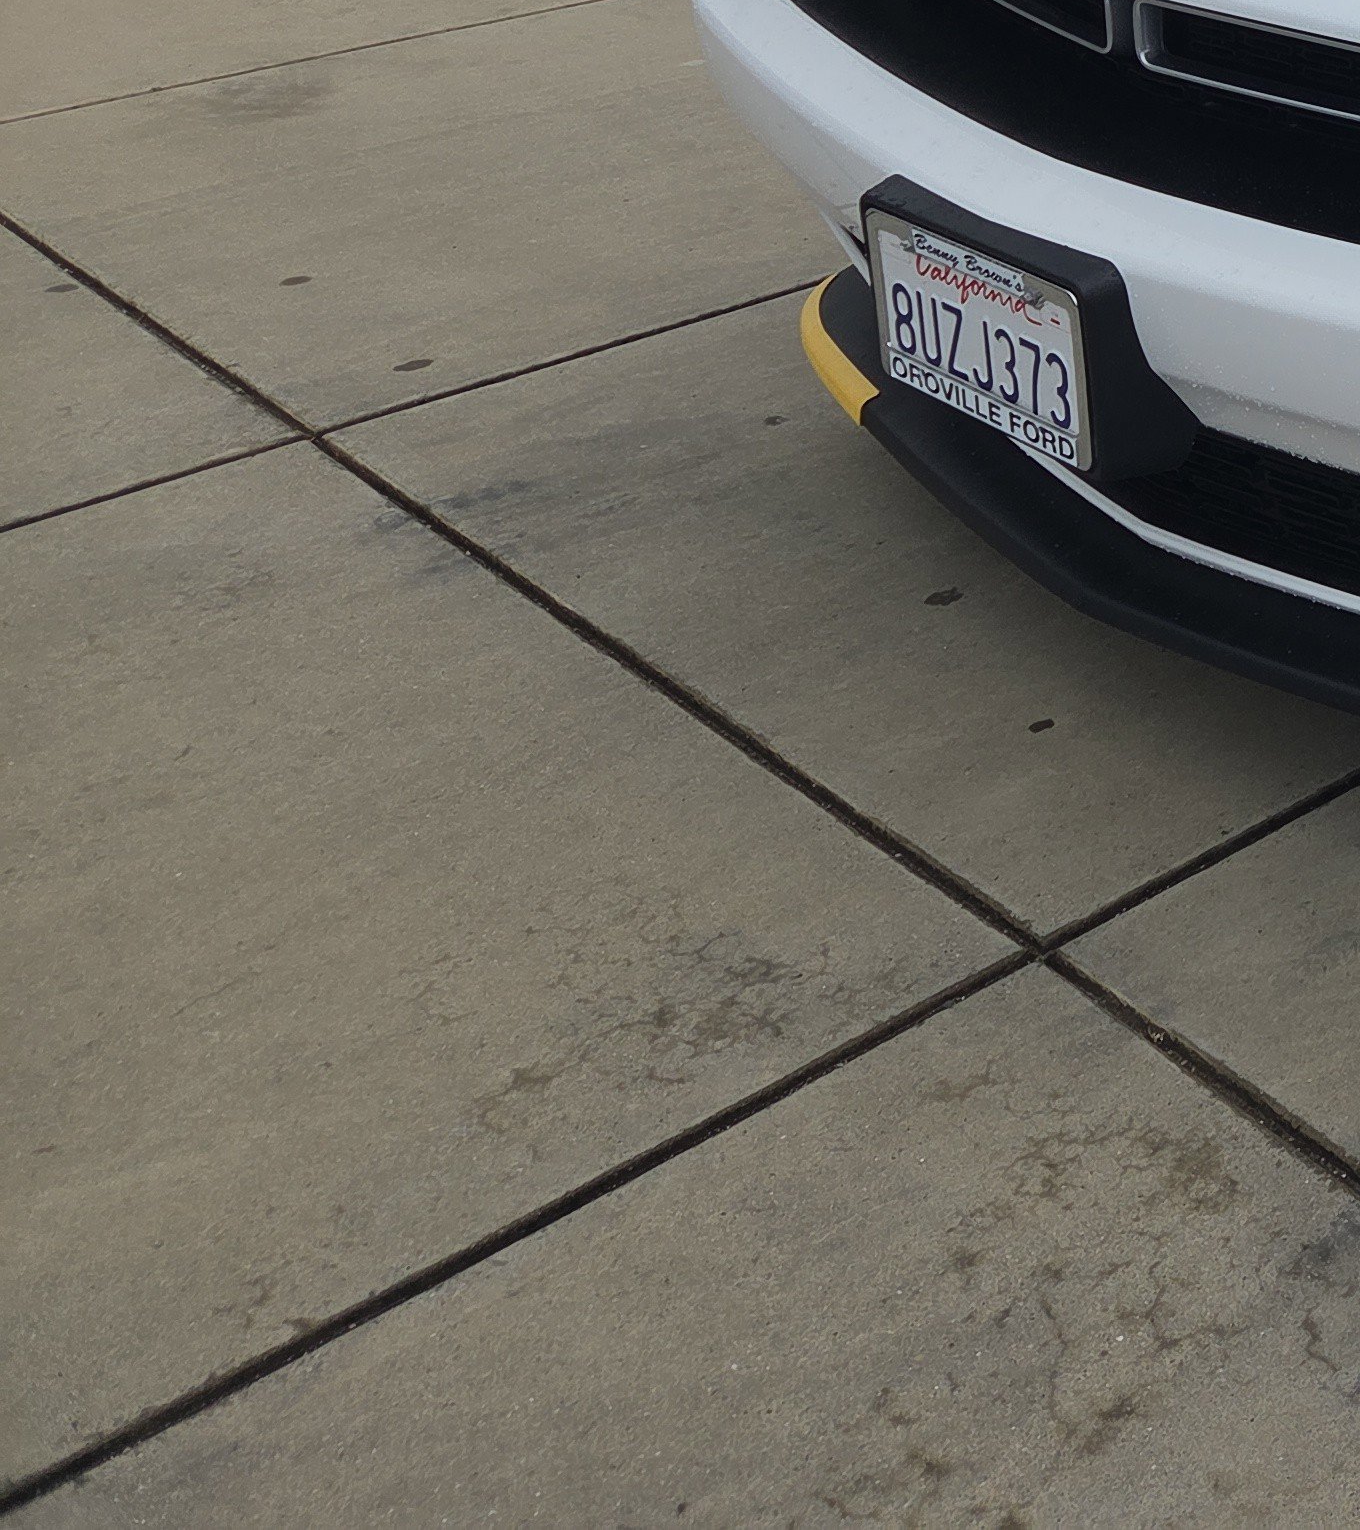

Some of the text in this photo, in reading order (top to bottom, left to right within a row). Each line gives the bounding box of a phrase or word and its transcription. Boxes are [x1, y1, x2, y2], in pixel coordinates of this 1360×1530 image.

[914, 233, 1024, 292] Benny Brown's
[916, 254, 1042, 326] California
[892, 282, 1071, 430] 8UZJ373
[892, 356, 1075, 461] OROVILLE FORD
